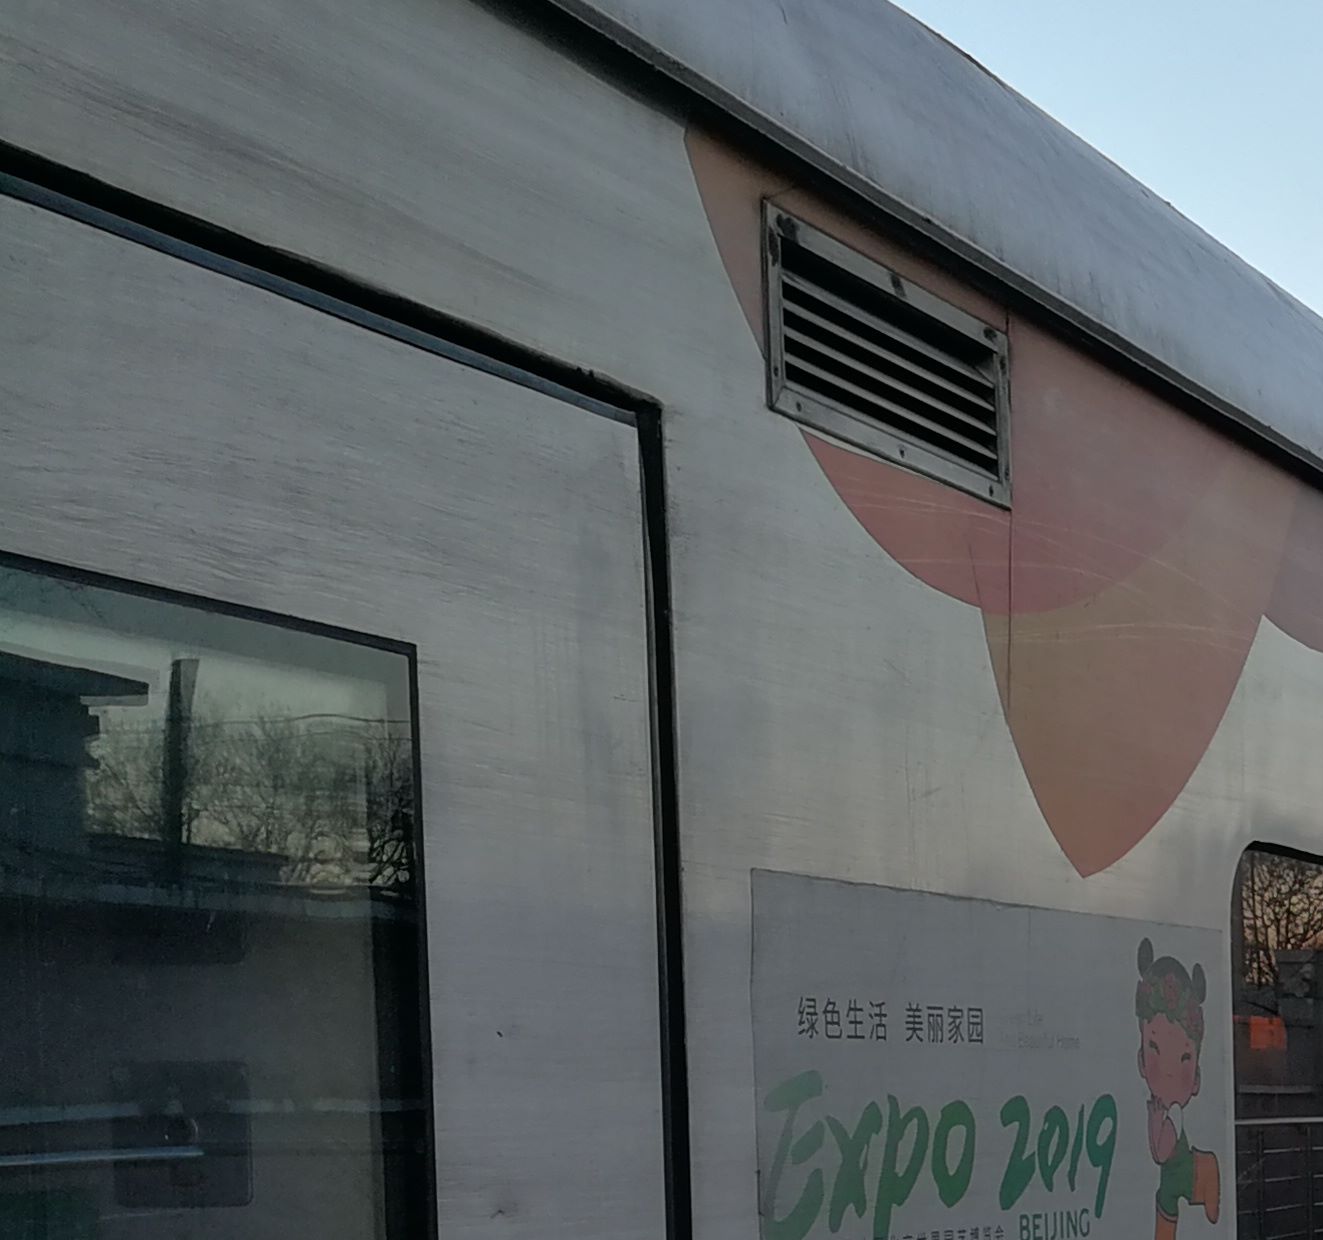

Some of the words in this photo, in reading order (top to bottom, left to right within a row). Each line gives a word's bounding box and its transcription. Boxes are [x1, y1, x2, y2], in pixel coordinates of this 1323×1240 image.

[797, 997, 888, 1041] 绿色生活
[904, 1002, 984, 1044] 美丽家园
[999, 1093, 1118, 1219] 2019
